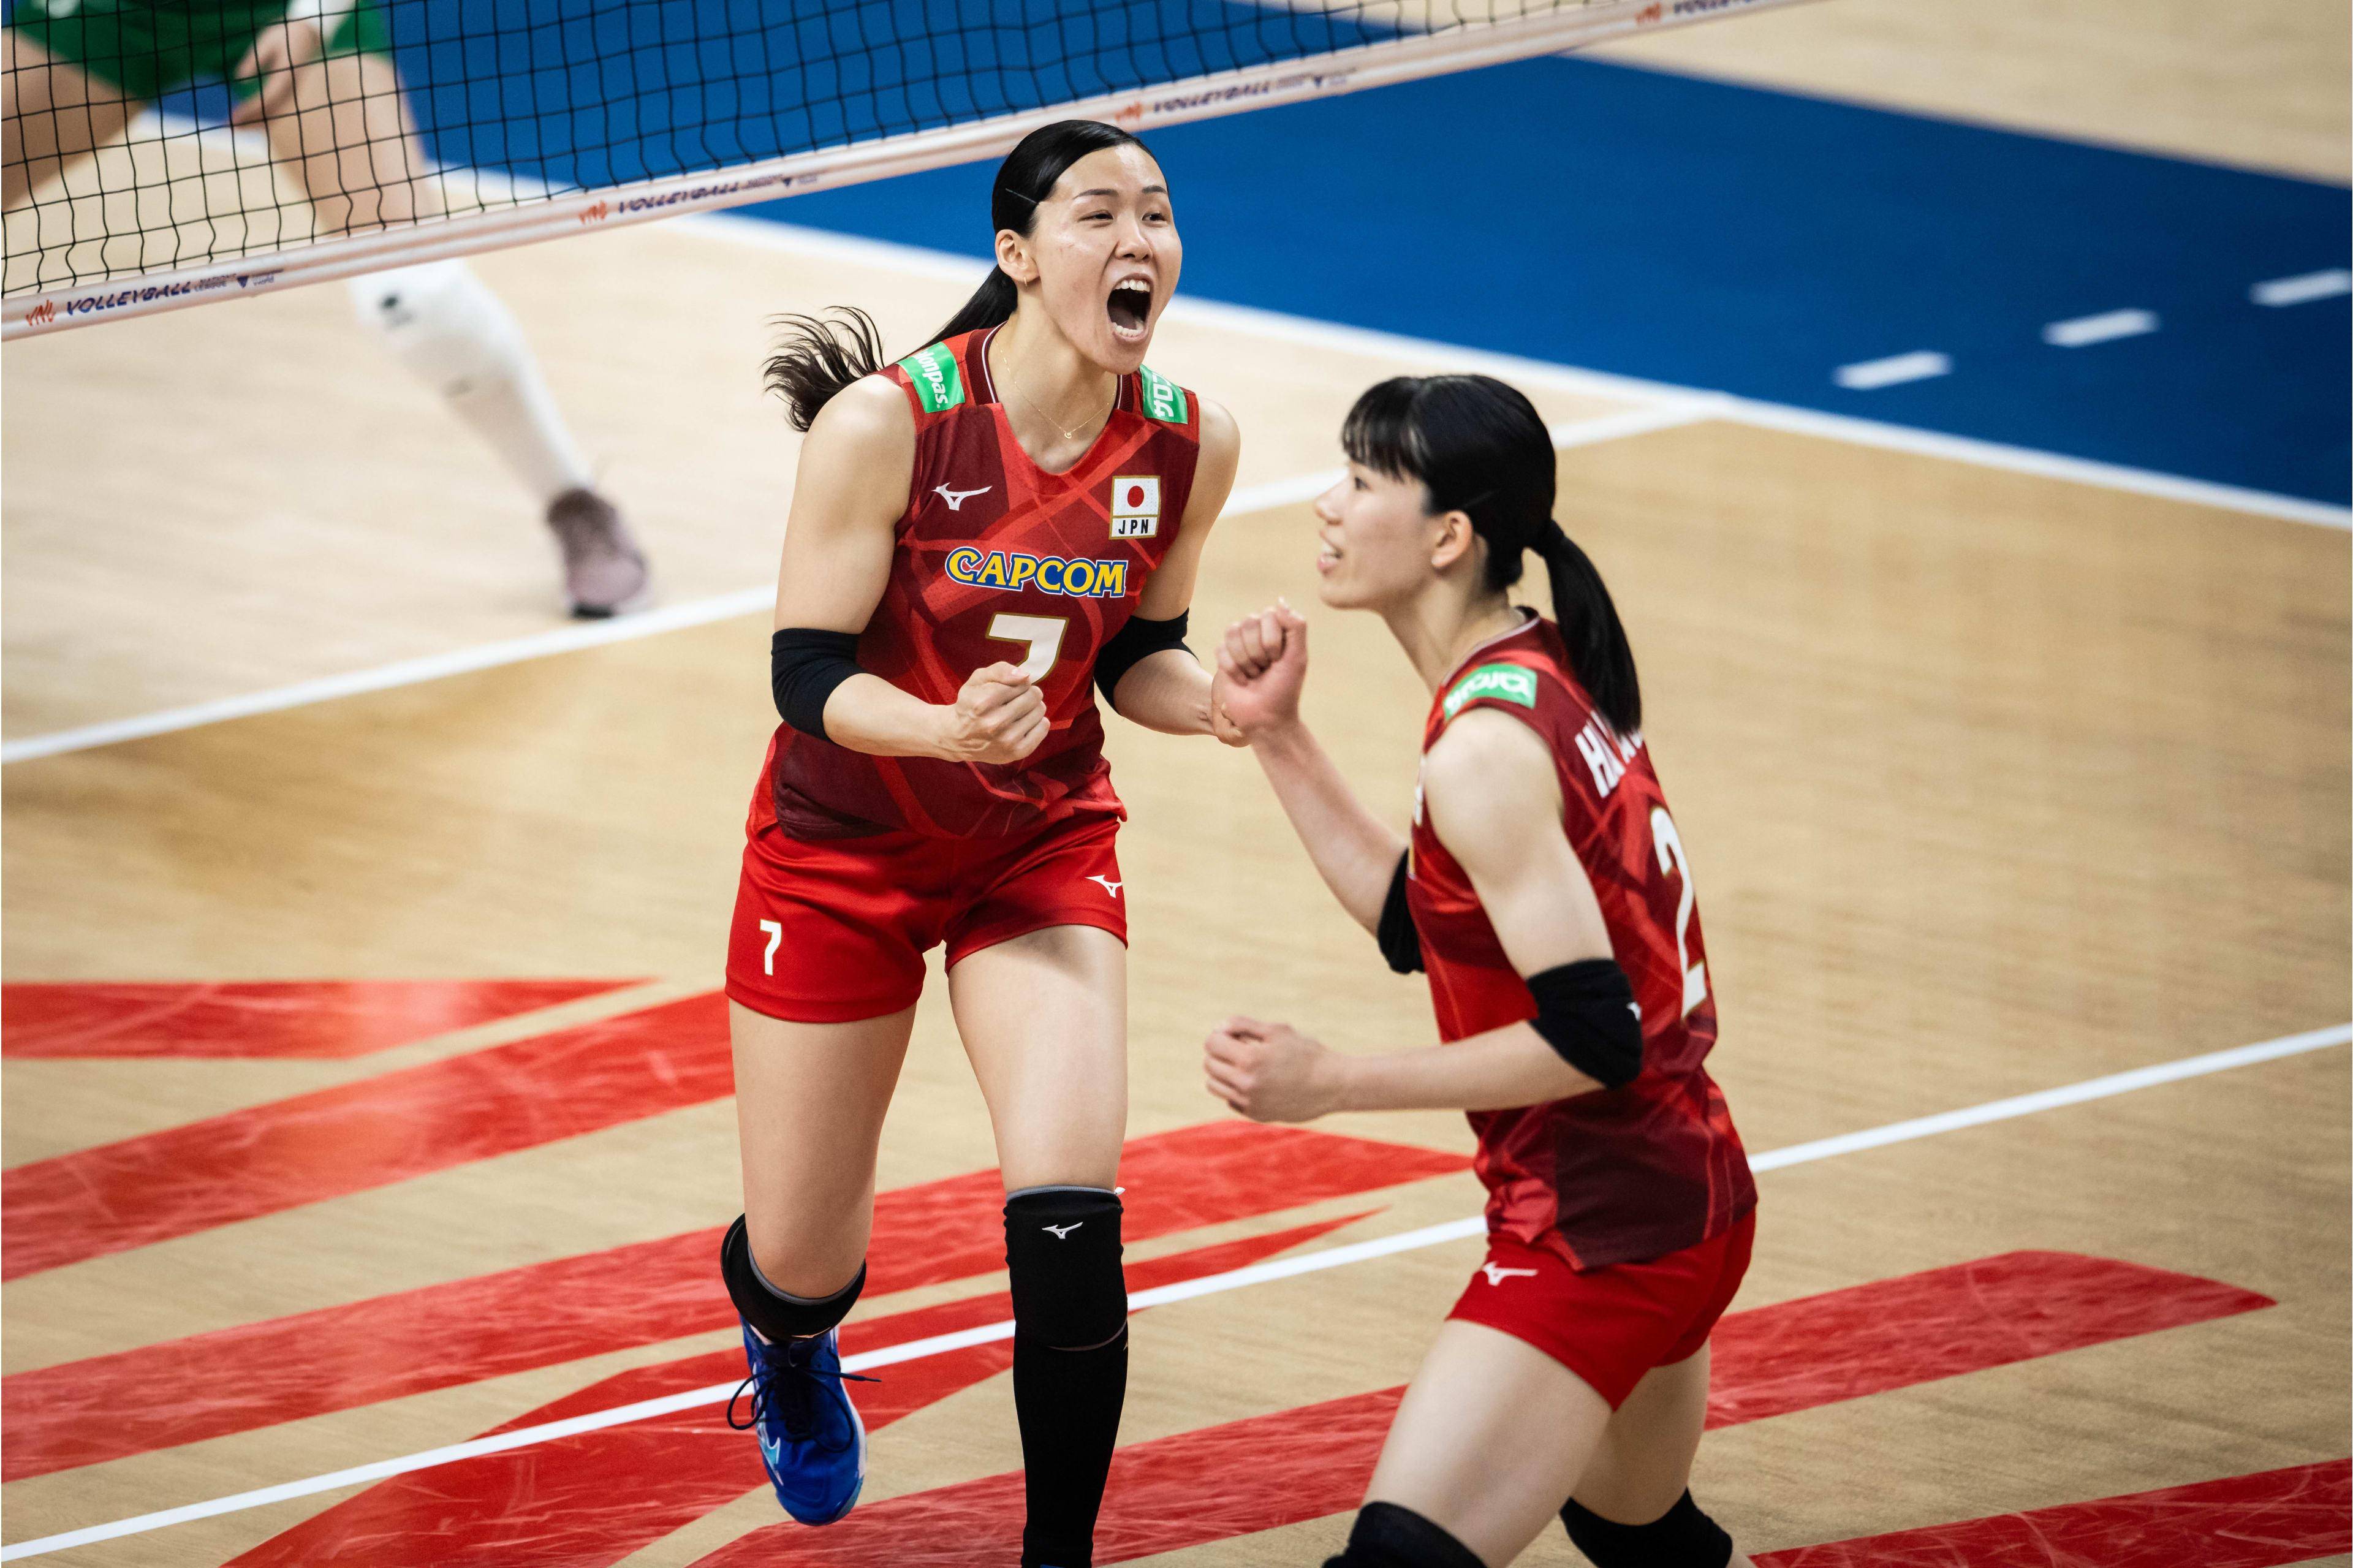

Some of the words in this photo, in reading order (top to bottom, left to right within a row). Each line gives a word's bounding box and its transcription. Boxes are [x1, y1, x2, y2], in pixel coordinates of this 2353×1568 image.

[66, 281, 191, 316] VOLLEYBALL
[1118, 519, 1149, 535] JPN
[945, 547, 1129, 598] CAPCOM
[986, 612, 1069, 684] 7
[1650, 806, 1708, 1023] 2
[760, 918, 782, 976] 7
